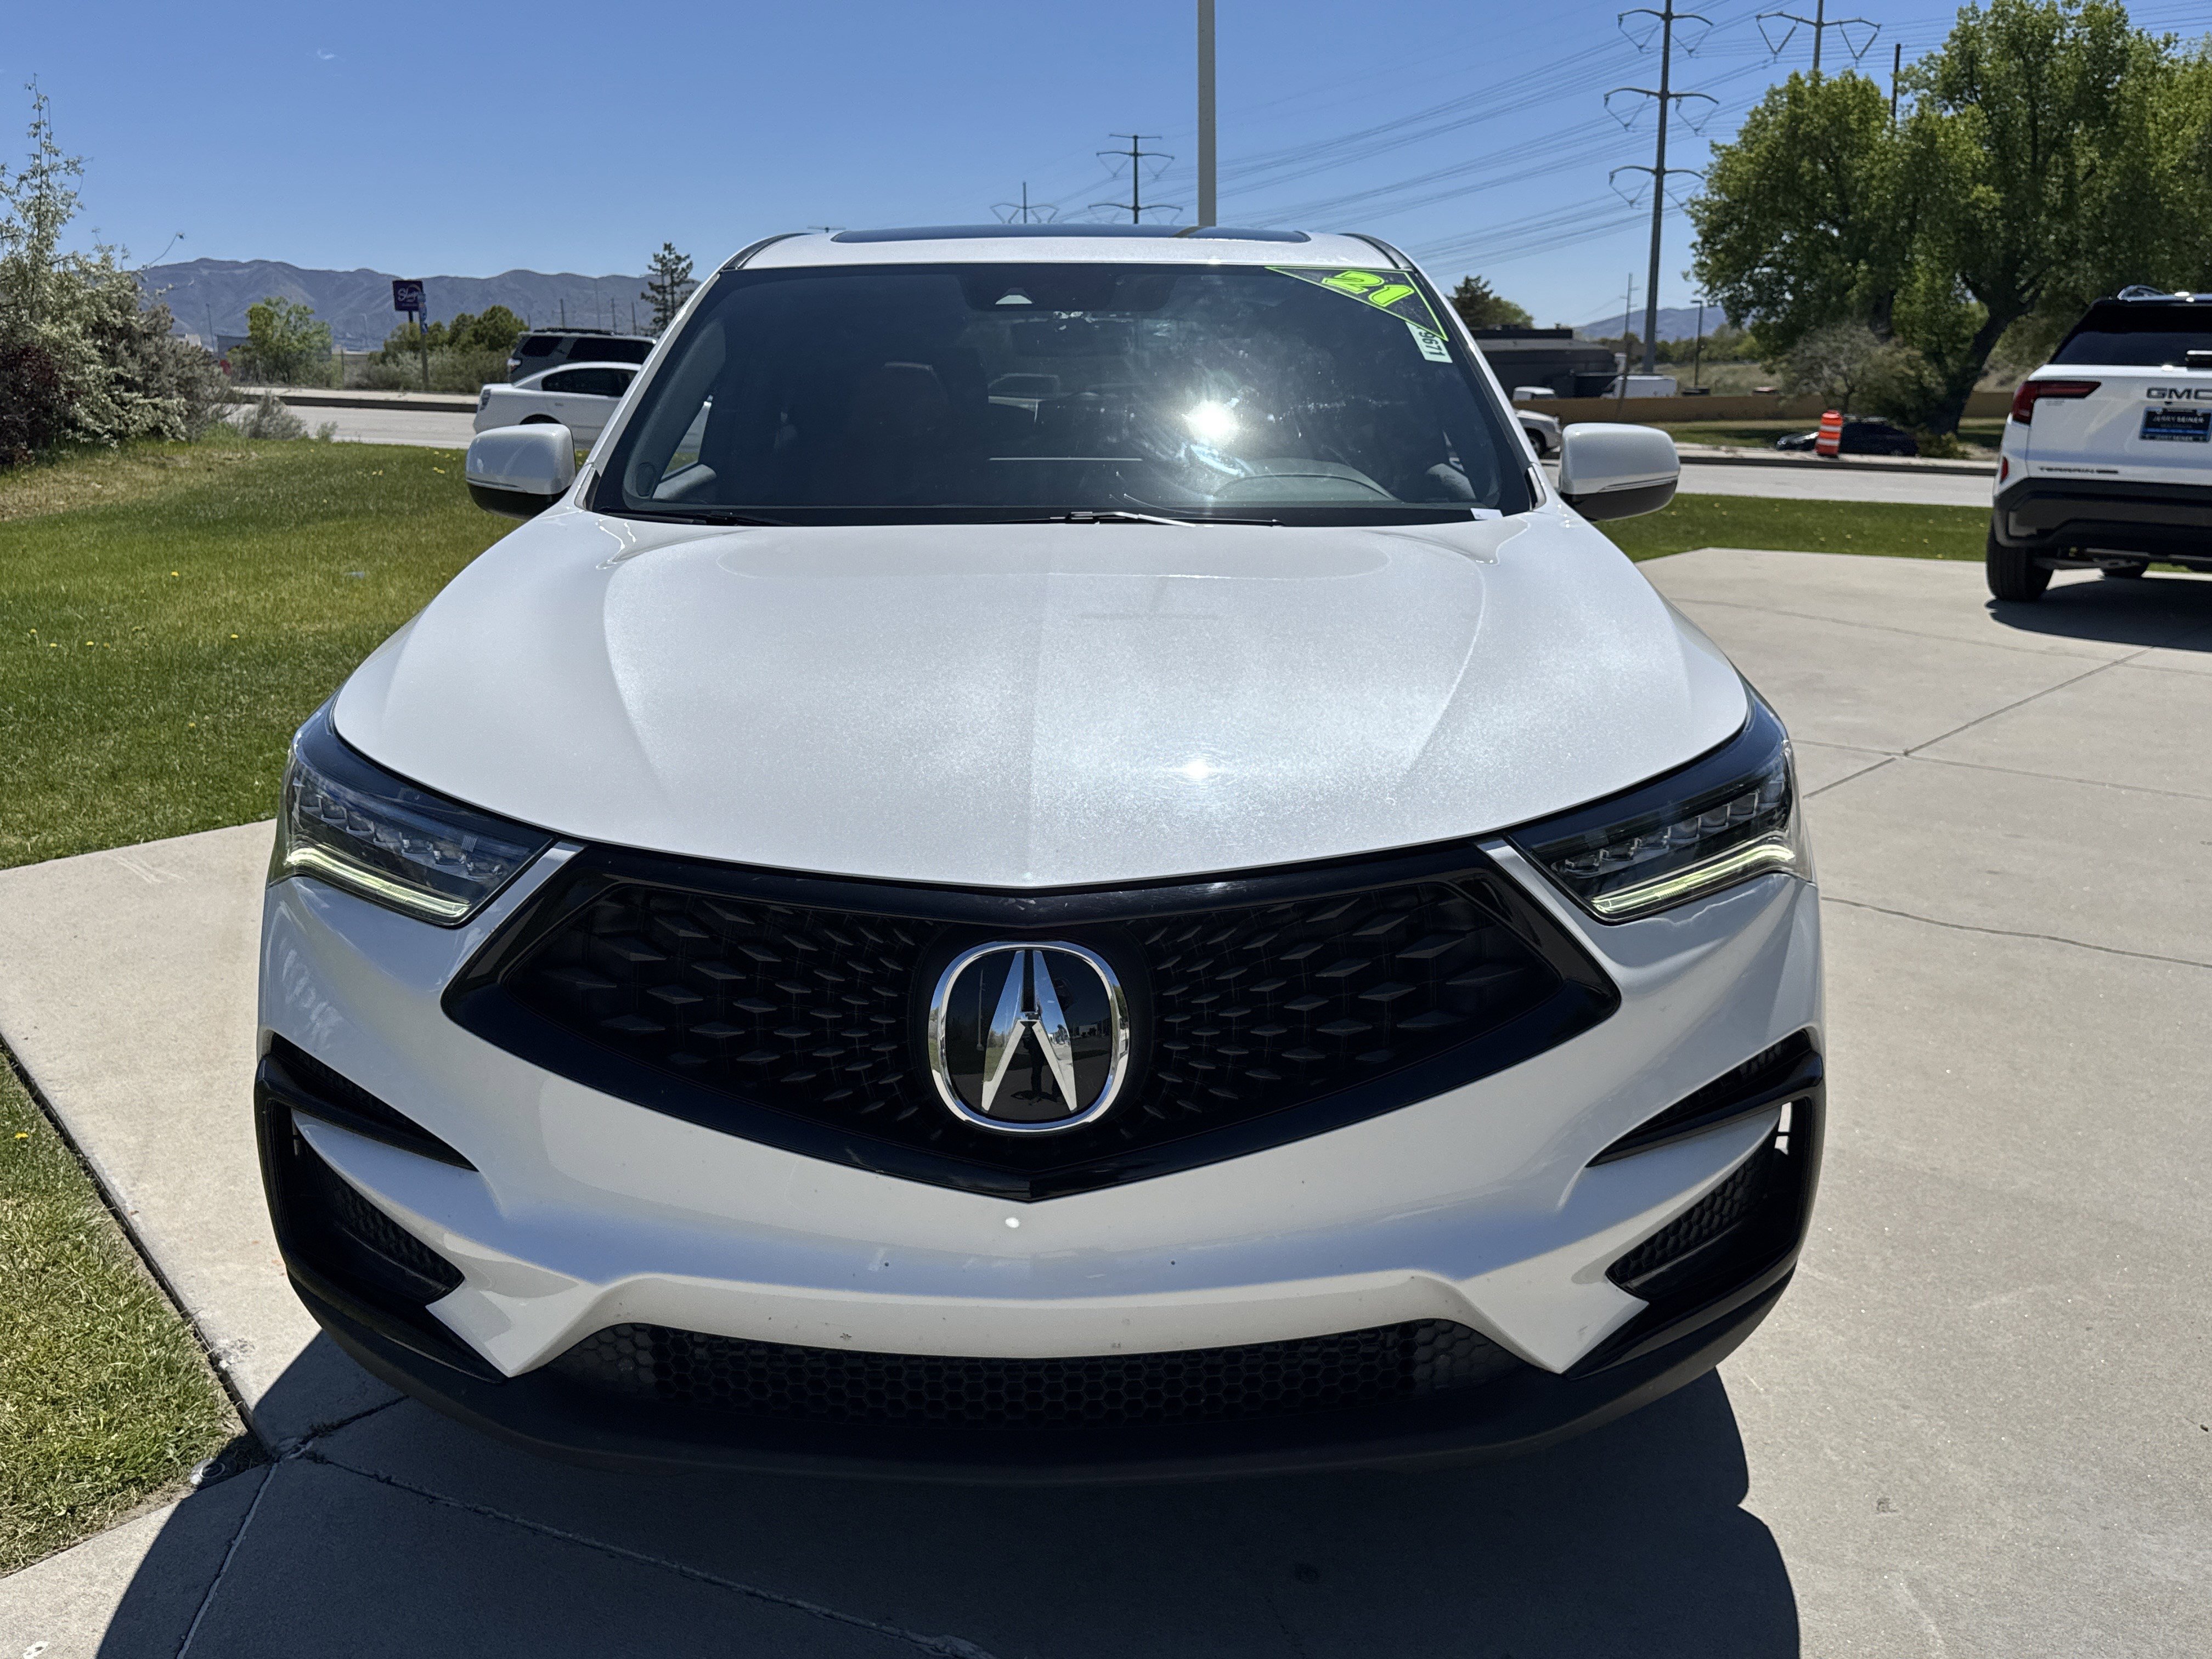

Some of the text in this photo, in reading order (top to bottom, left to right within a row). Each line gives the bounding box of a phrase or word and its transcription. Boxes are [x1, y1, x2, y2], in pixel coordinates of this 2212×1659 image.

[1322, 270, 1414, 307] 21
[1418, 330, 1446, 356] 9671
[2146, 387, 2212, 400] GMC
